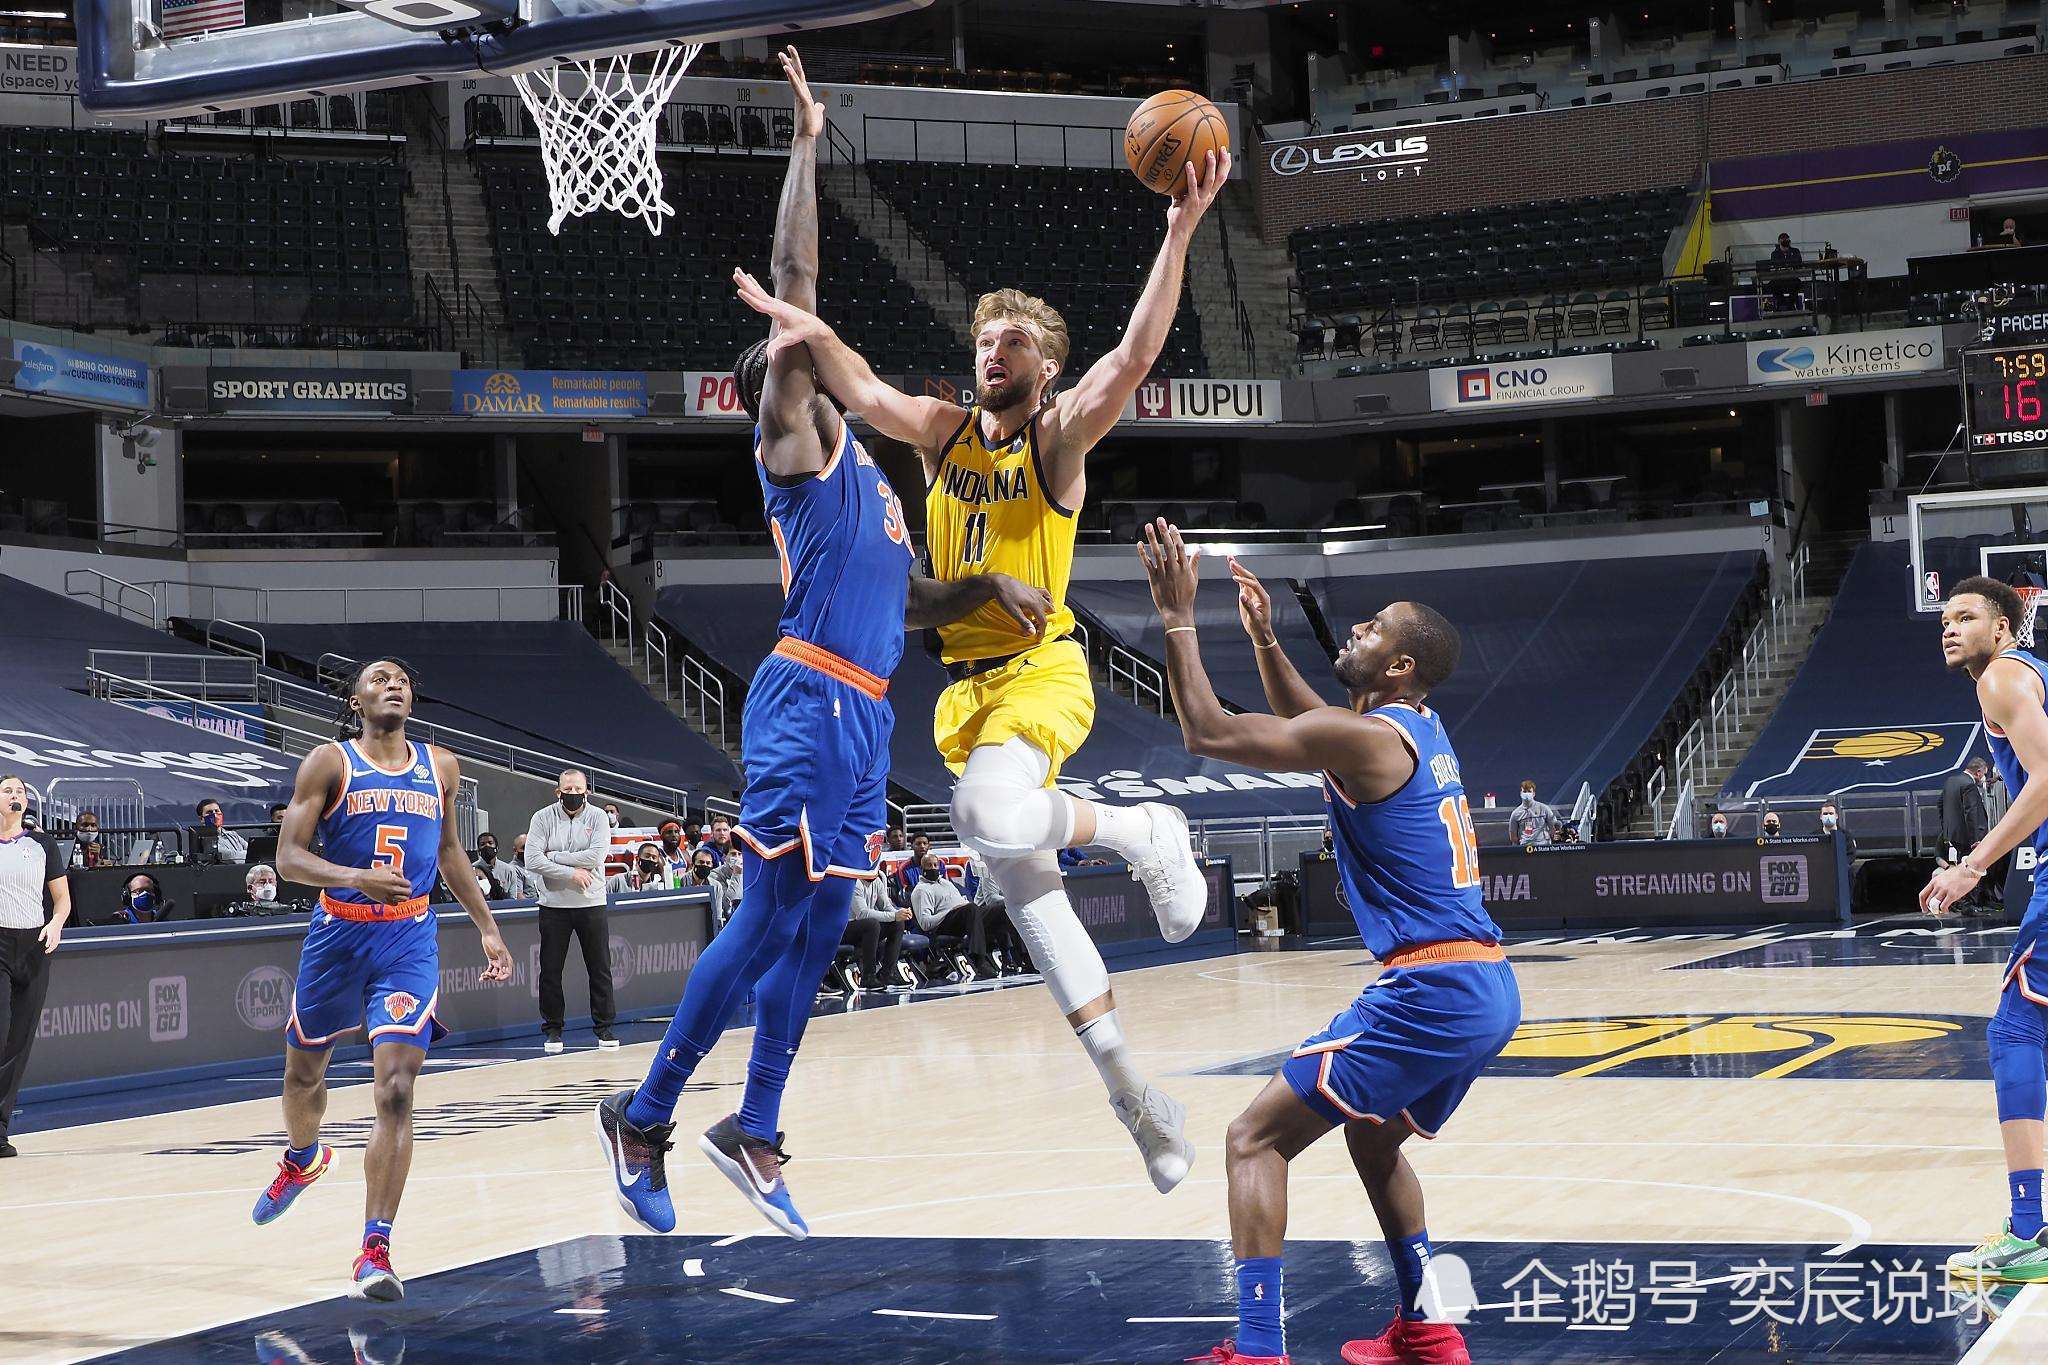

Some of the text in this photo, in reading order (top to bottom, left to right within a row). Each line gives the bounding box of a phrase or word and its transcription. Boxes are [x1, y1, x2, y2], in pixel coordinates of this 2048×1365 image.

[6, 53, 67, 72] NEED
[0, 73, 58, 91] (space)
[736, 88, 751, 101] 108
[840, 94, 853, 107] 109
[1143, 133, 1182, 183] SPALDI
[1313, 136, 1428, 164] LEXUS
[1361, 167, 1422, 182] LOFT
[1827, 340, 1933, 364] Kinetico
[24, 361, 54, 372] salesforce
[98, 364, 137, 378] COMPANIES
[1794, 361, 1901, 378] water systems
[1995, 353, 2045, 378] 7:59
[112, 376, 145, 390] TOGETHER
[553, 377, 644, 392] Remarkable people.
[1496, 368, 1547, 388] CNO
[213, 381, 407, 400] SPORT GRAPHICS
[696, 376, 745, 411] PO
[1179, 383, 1263, 416] IUPUI
[1496, 385, 1585, 400] FINANCIAL GROUP
[2003, 380, 2041, 421] 16
[463, 393, 544, 413] DAMAR
[553, 396, 608, 409] Remarkable
[1764, 525, 1771, 541] 9
[1882, 516, 1895, 534] 11
[962, 511, 987, 563] 11
[655, 561, 663, 577] 8
[346, 788, 439, 821] NEW YORK
[371, 824, 408, 870] 5
[1767, 861, 1799, 875] FOX
[1595, 871, 1751, 897] STREAMING ON
[1769, 883, 1800, 896] GO
[1080, 895, 1125, 925] INDIANA
[636, 941, 698, 975] INDIANA
[154, 983, 180, 1003] FOX
[249, 978, 283, 1007] FOX
[116, 1000, 142, 1030] ON
[156, 1012, 180, 1032] GO
